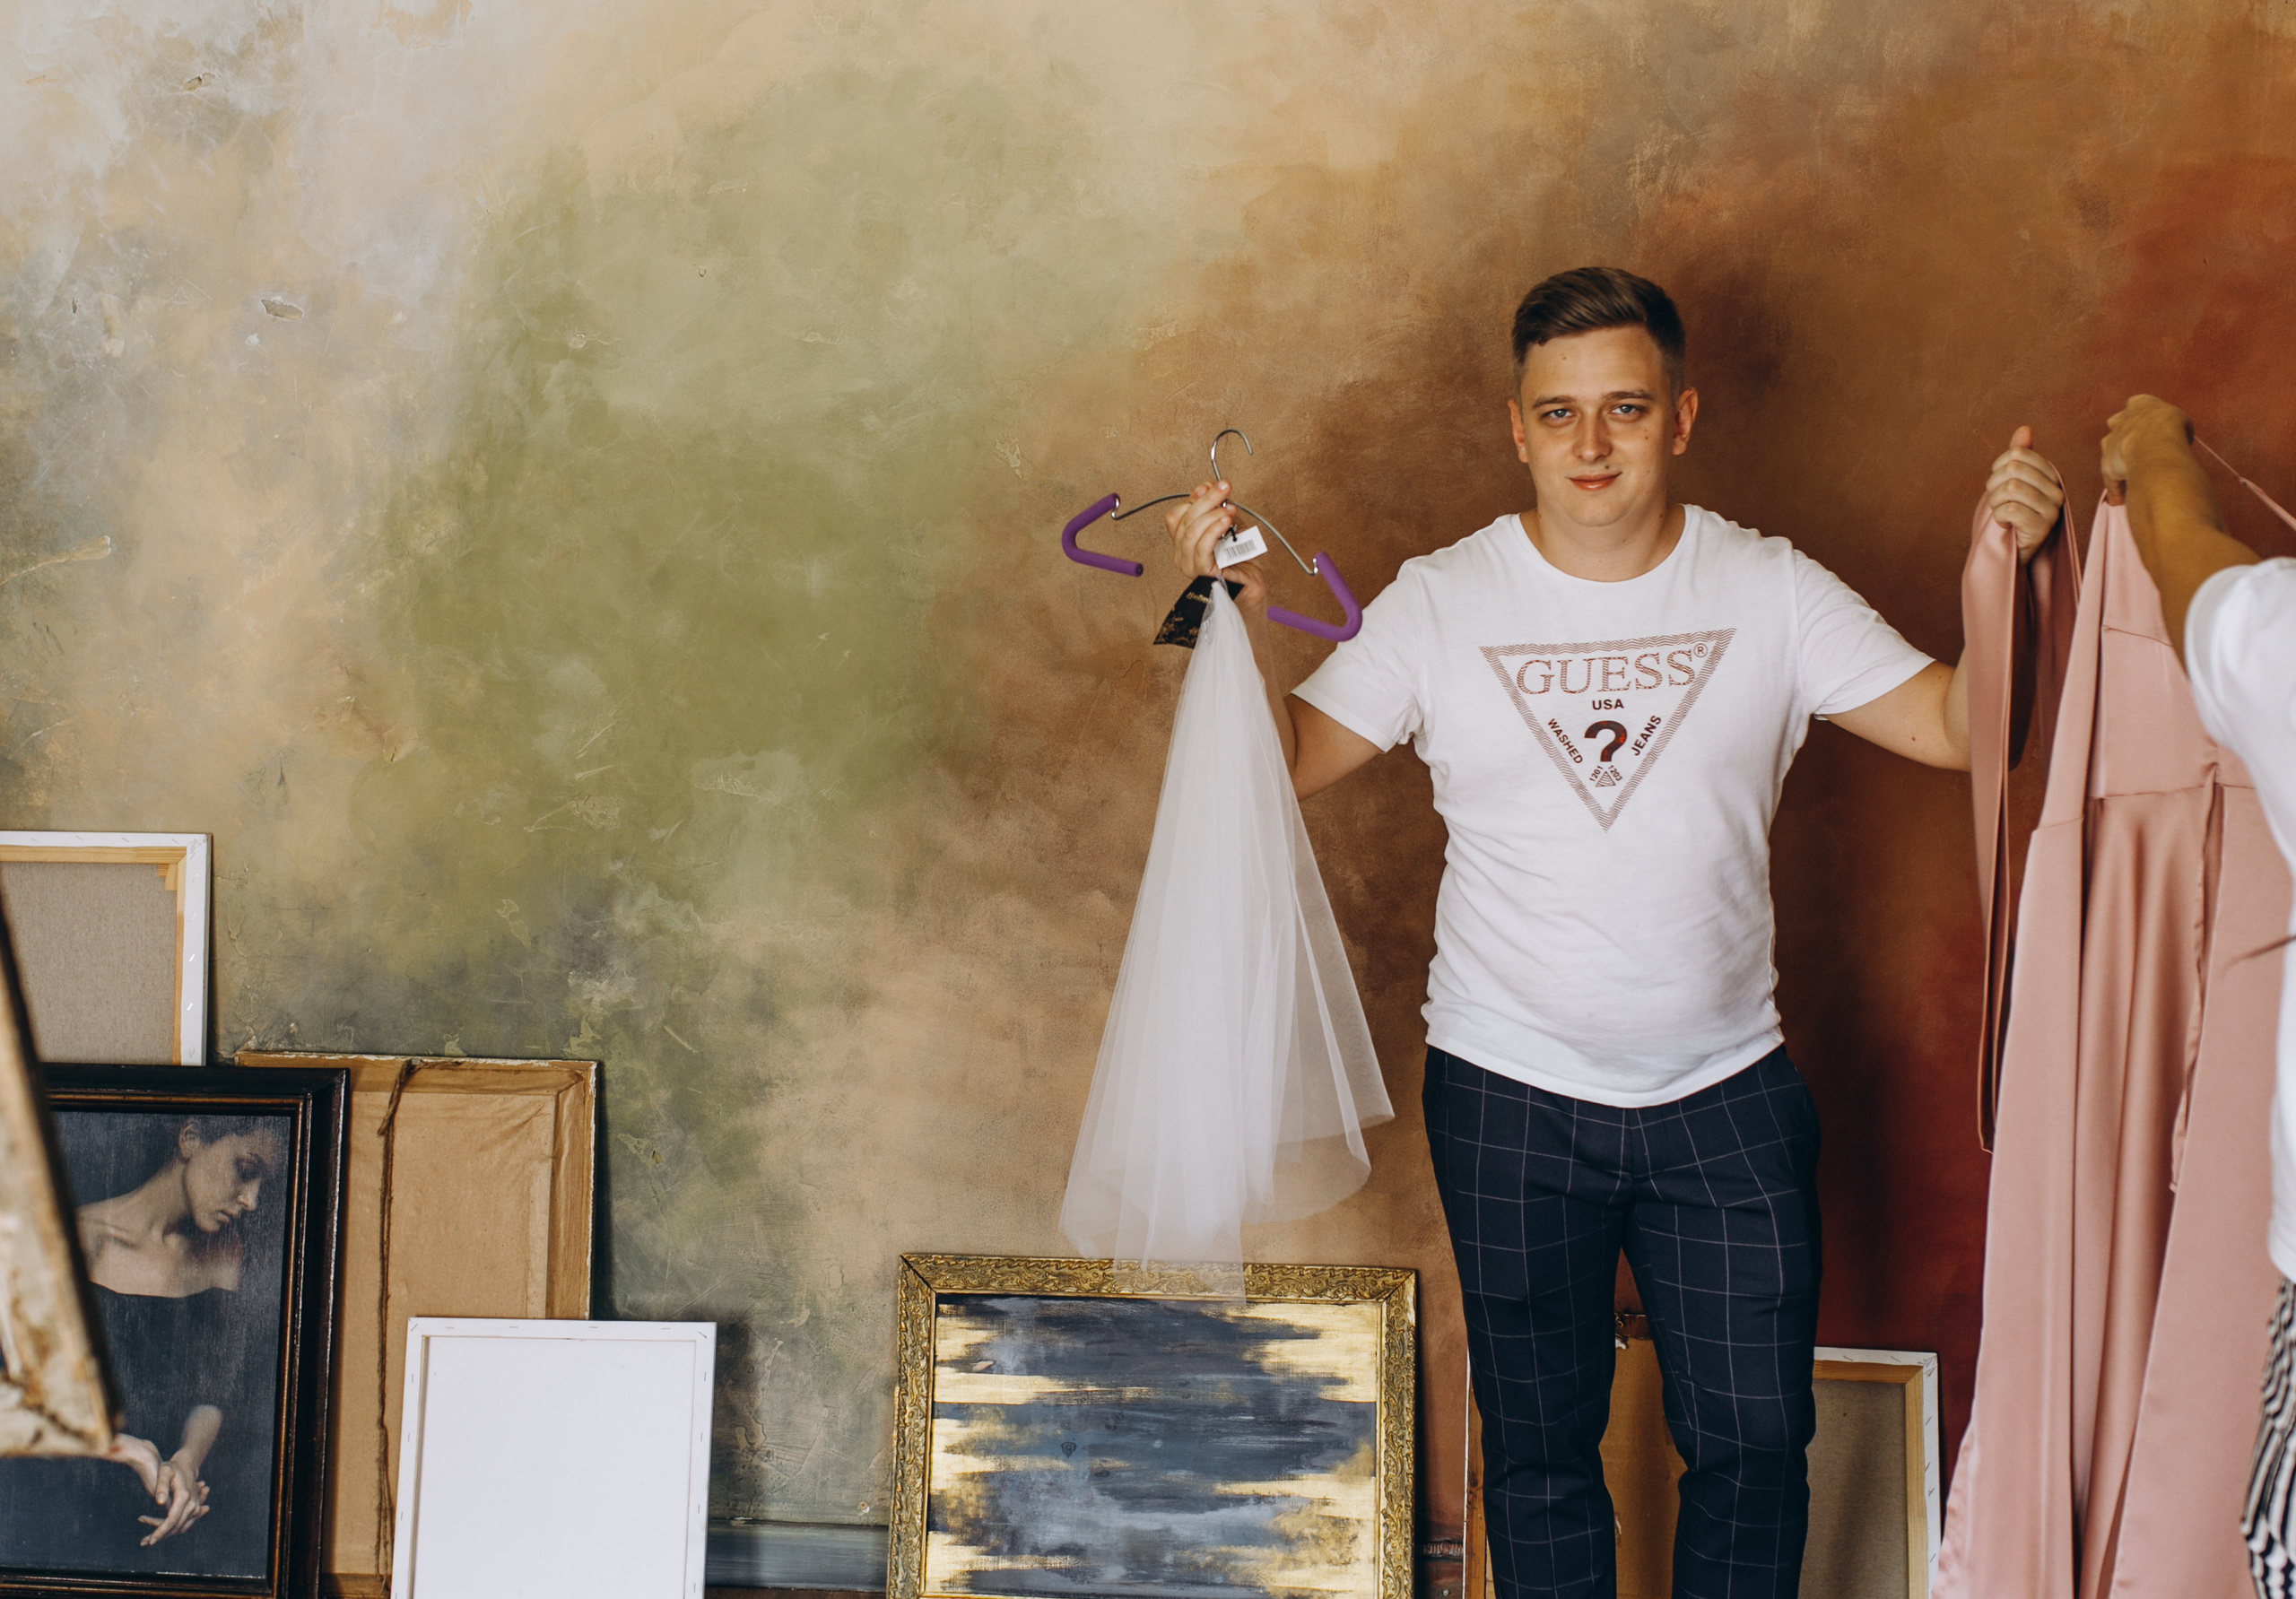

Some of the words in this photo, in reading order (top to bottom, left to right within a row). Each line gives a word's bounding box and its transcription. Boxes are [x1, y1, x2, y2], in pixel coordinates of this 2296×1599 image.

[1592, 699, 1624, 710] USA
[1547, 718, 1583, 764] WASHED
[1584, 720, 1628, 762] ?
[1631, 715, 1662, 756] JEANS
[1588, 765, 1604, 782] 1201
[1608, 765, 1623, 782] 1203
